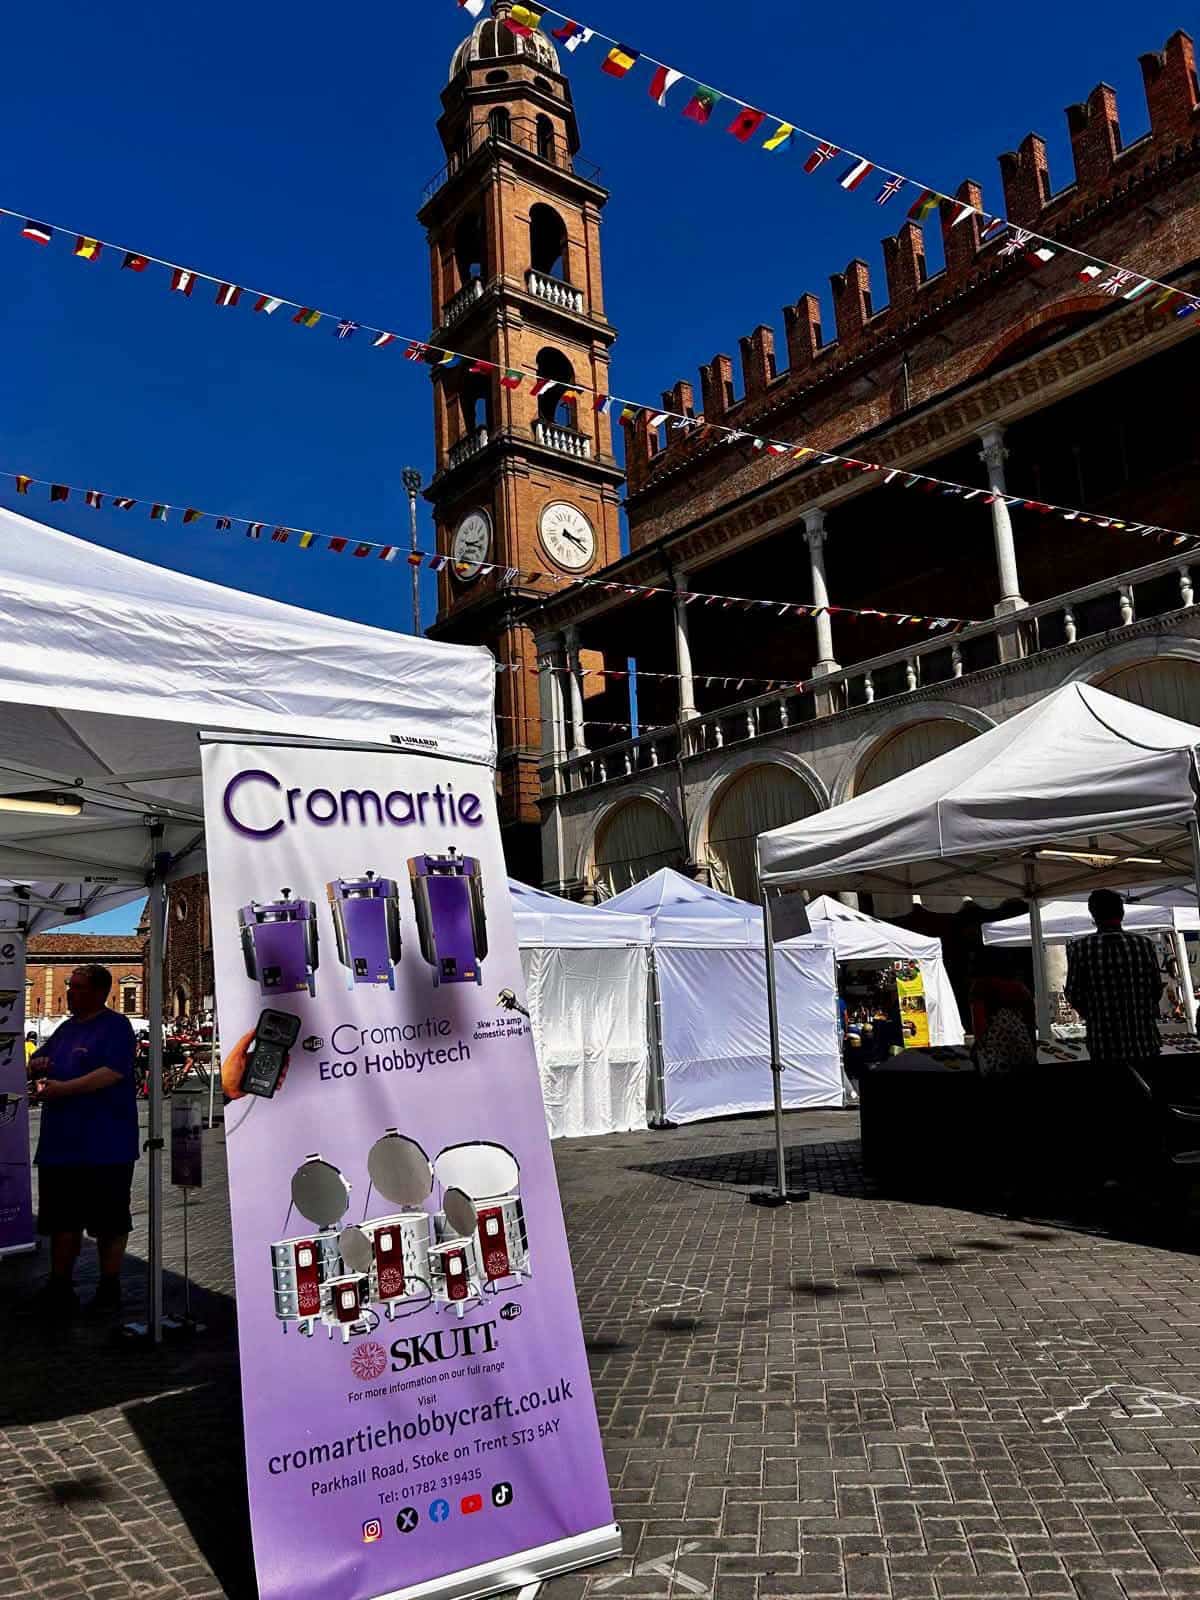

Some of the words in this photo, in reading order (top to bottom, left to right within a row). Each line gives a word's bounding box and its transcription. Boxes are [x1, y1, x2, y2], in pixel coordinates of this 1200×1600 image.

[223, 769, 484, 840] Cromartie
[331, 1017, 452, 1055] Cromartie
[473, 1029, 505, 1040] domestic
[507, 1027, 522, 1037] plug
[496, 1018, 505, 1027] 13
[506, 1017, 521, 1026] amp
[319, 1060, 357, 1081] Eco
[365, 1041, 471, 1075] Hobbytech
[390, 1319, 497, 1372] SKUTT
[348, 1391, 363, 1403] For
[365, 1387, 387, 1398] more
[439, 1371, 450, 1381] on
[451, 1368, 465, 1378] our
[467, 1363, 480, 1375] full
[482, 1361, 505, 1373] range
[418, 1394, 437, 1406] Visit
[268, 1378, 574, 1476] cromartiehobbycraft.co.uk
[312, 1469, 367, 1497] Parkhall
[371, 1459, 409, 1481] Road,
[412, 1450, 449, 1470] Stoke
[454, 1446, 470, 1459] on
[474, 1435, 509, 1453] Trent
[511, 1428, 535, 1446] ST3
[538, 1418, 560, 1438] 5AY
[378, 1490, 399, 1505] Tel:
[402, 1479, 437, 1499] 01782
[440, 1467, 482, 1489] 319435
